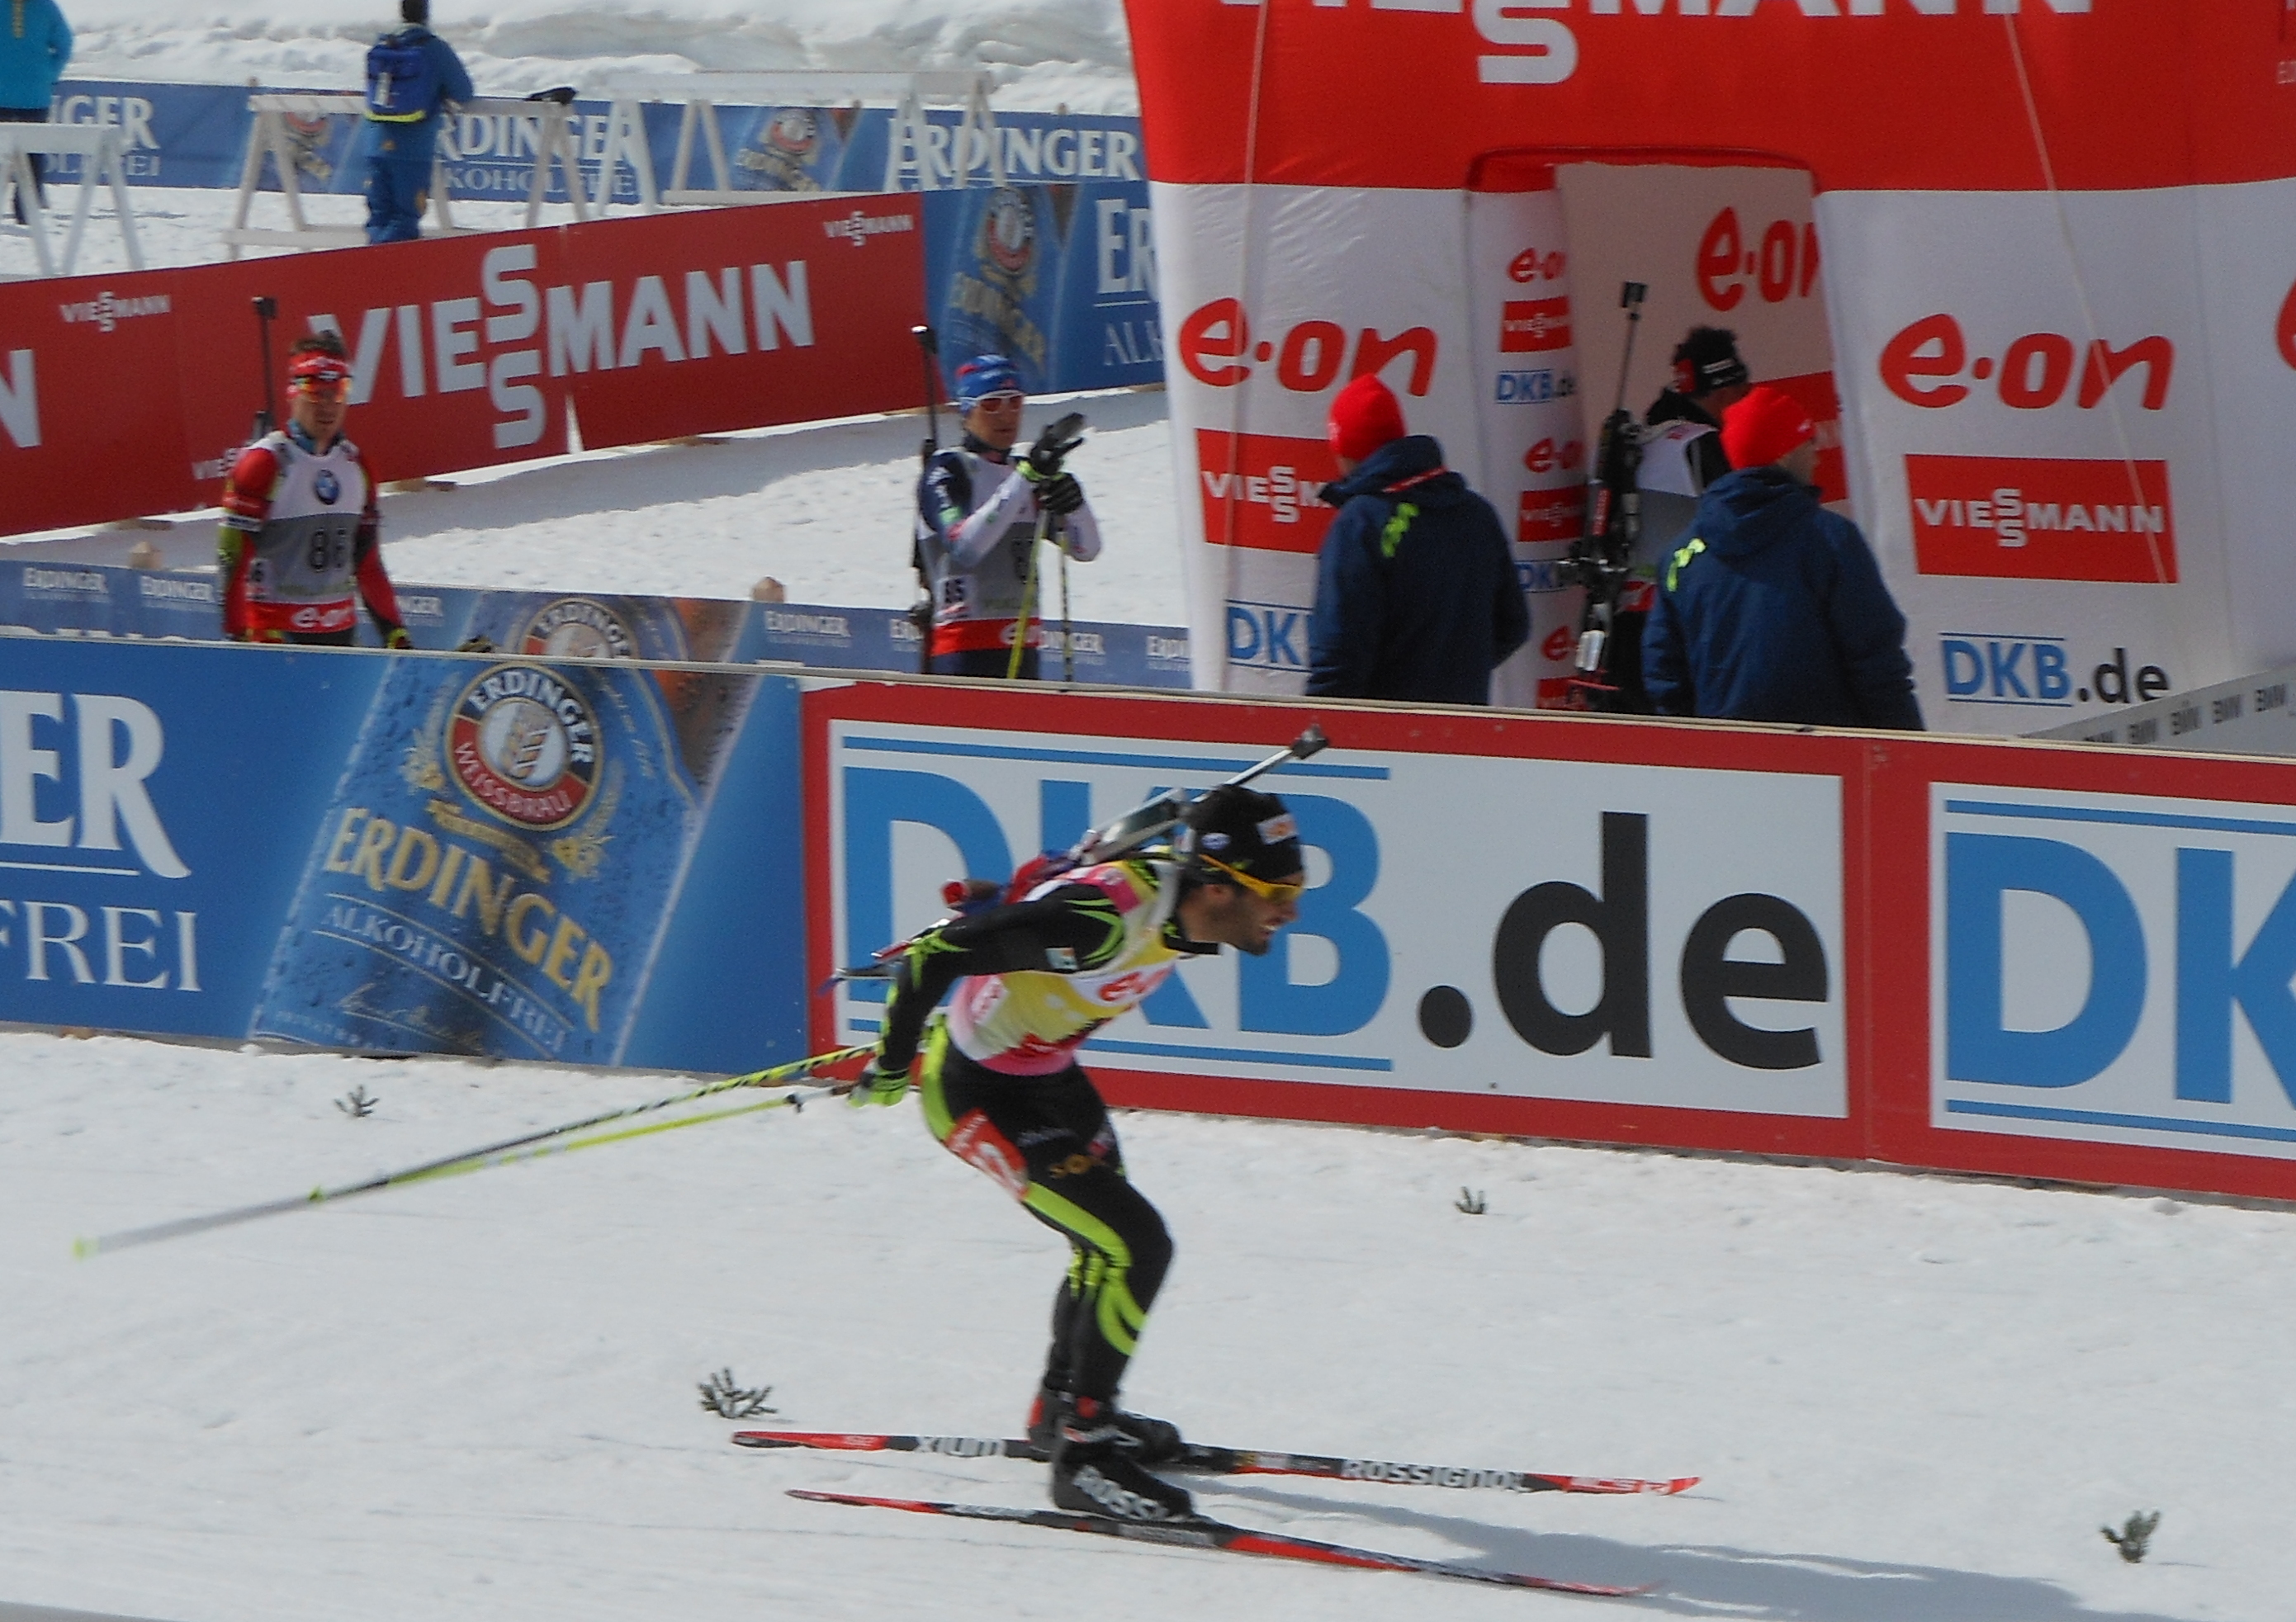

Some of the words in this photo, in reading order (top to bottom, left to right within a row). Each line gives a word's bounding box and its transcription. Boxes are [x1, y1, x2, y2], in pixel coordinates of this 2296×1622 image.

[307, 244, 815, 448] VIESSMANN
[1914, 488, 2164, 548] VIESSMANN
[468, 671, 594, 763] ERDINGER
[1941, 639, 2171, 704] DKB.de
[323, 806, 613, 1033] ERDINGER
